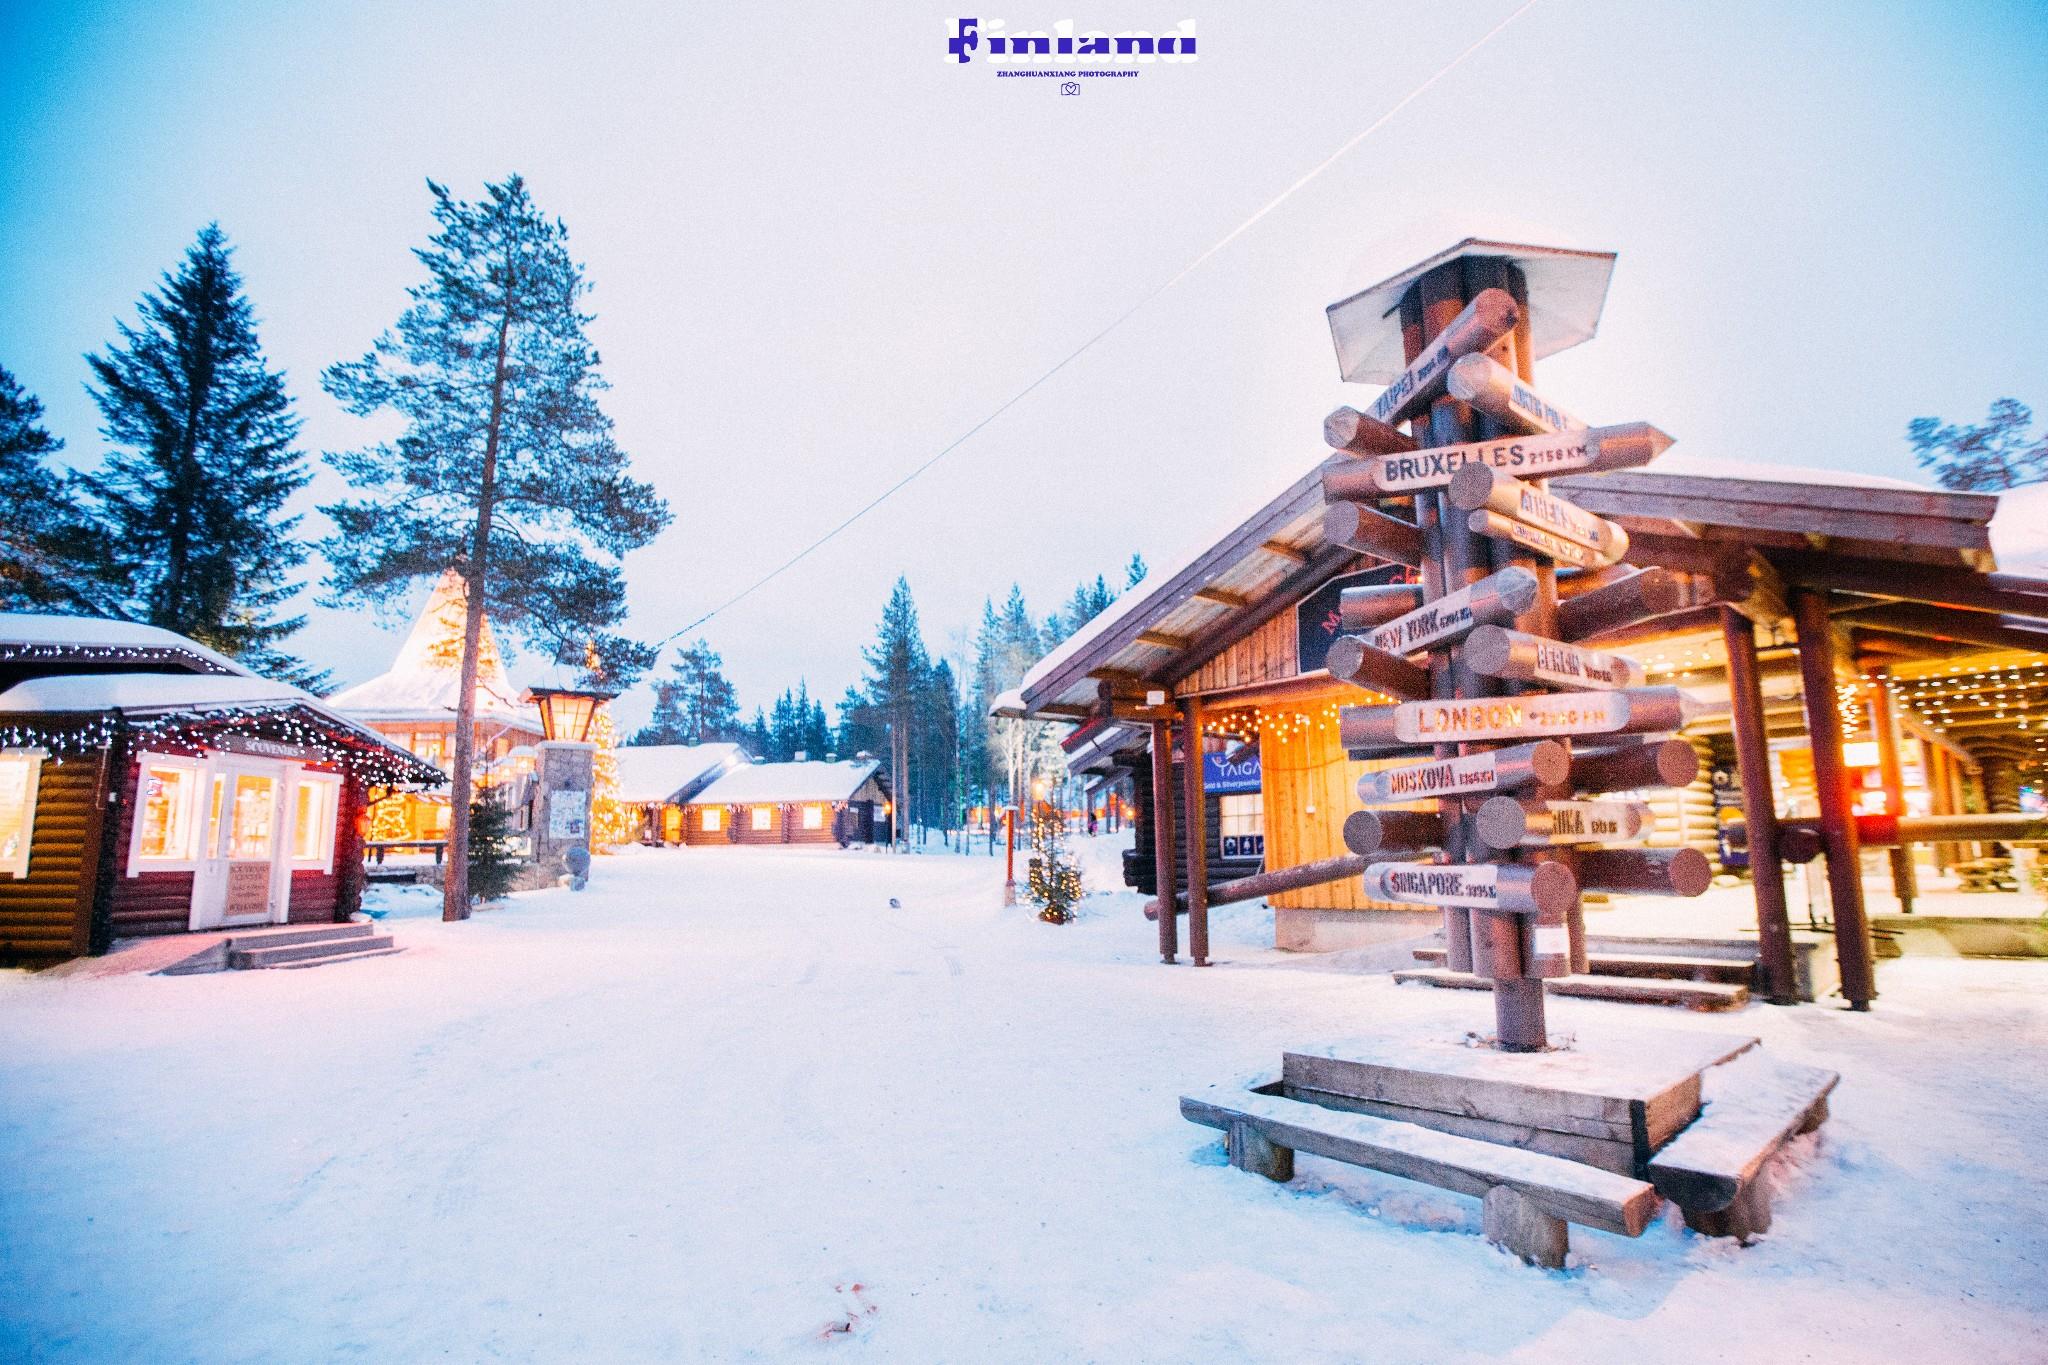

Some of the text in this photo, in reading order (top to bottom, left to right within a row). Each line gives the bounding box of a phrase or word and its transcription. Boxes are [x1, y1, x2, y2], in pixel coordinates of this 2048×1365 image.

[1406, 609, 1439, 642] YORK
[1418, 704, 1522, 733] LONDON
[1391, 764, 1455, 795] MOSKOVA
[1391, 871, 1464, 897] SINGAPORE
